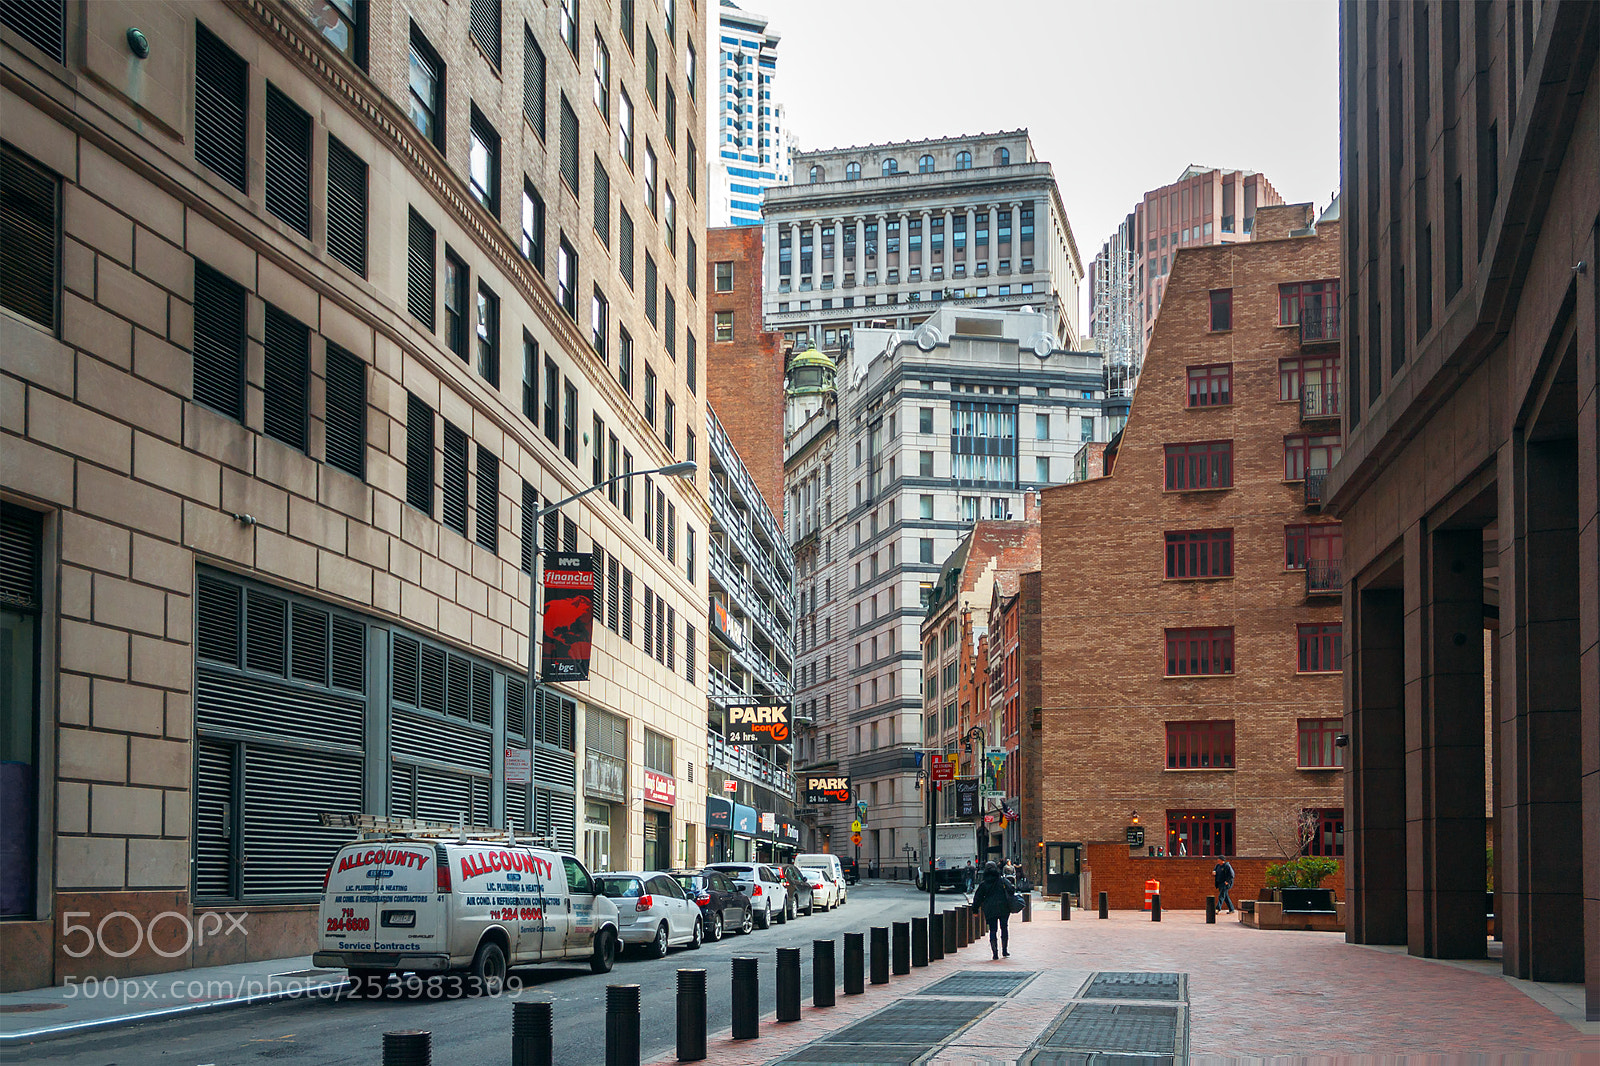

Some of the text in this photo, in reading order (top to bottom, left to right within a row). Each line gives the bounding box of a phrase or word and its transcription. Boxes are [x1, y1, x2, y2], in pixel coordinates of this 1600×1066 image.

[558, 557, 580, 567] NYC
[546, 571, 593, 582] financial
[558, 662, 575, 673] bgc
[729, 706, 788, 724] PARK
[751, 723, 772, 732] icon
[730, 731, 758, 742] 24 hrs.
[808, 778, 849, 790] PARK
[337, 850, 430, 874] ALLCOUNTY
[460, 850, 553, 882] ALLCOUNTY
[486, 883, 497, 892] LIC.
[497, 883, 520, 892] PLUMBING
[467, 897, 476, 906] AIR
[341, 908, 355, 918] 718
[490, 907, 542, 921] 718 284 6600
[326, 917, 370, 932] 284-6600
[338, 941, 421, 951] Service Contracts
